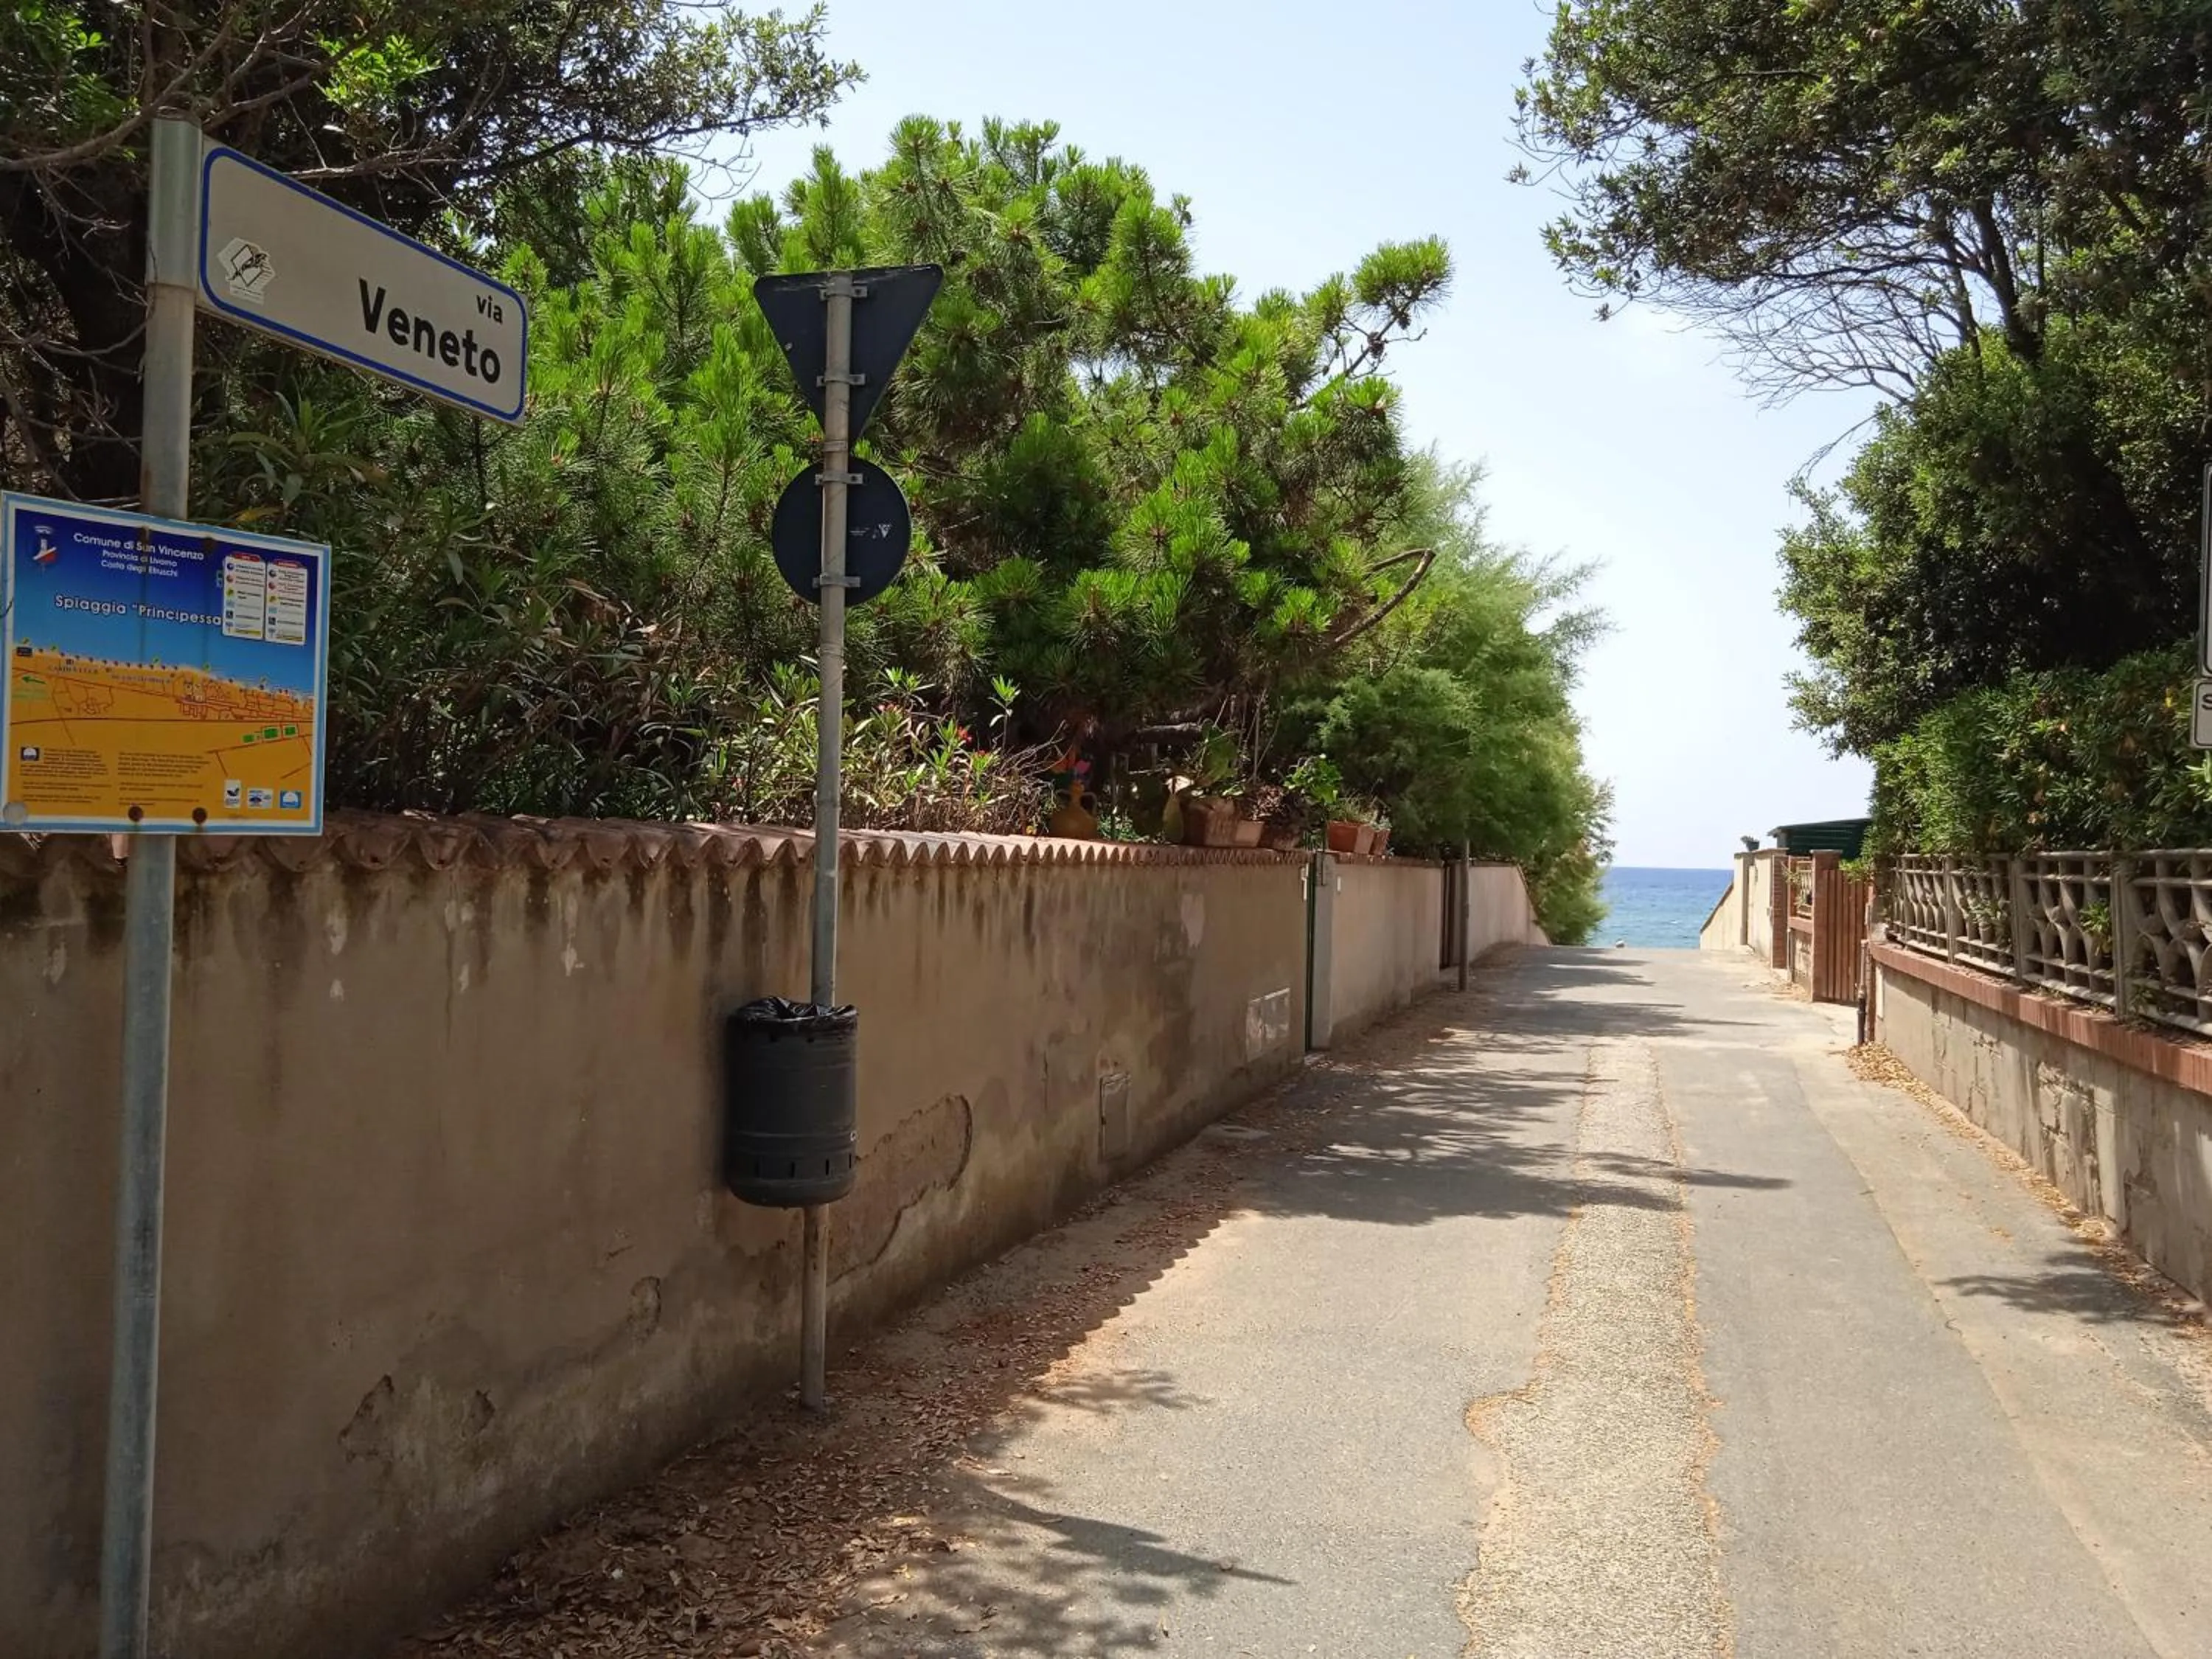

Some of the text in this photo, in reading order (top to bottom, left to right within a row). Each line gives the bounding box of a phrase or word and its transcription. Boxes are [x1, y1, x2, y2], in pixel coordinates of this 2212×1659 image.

[476, 294, 504, 324] via
[358, 276, 501, 384] Veneto
[73, 532, 205, 561] Comune di San Vincenzo
[102, 549, 139, 562] Provincia
[150, 556, 178, 568] Livorno
[100, 560, 178, 578] Costa degli Etruschi
[55, 594, 127, 615] Spiaggia
